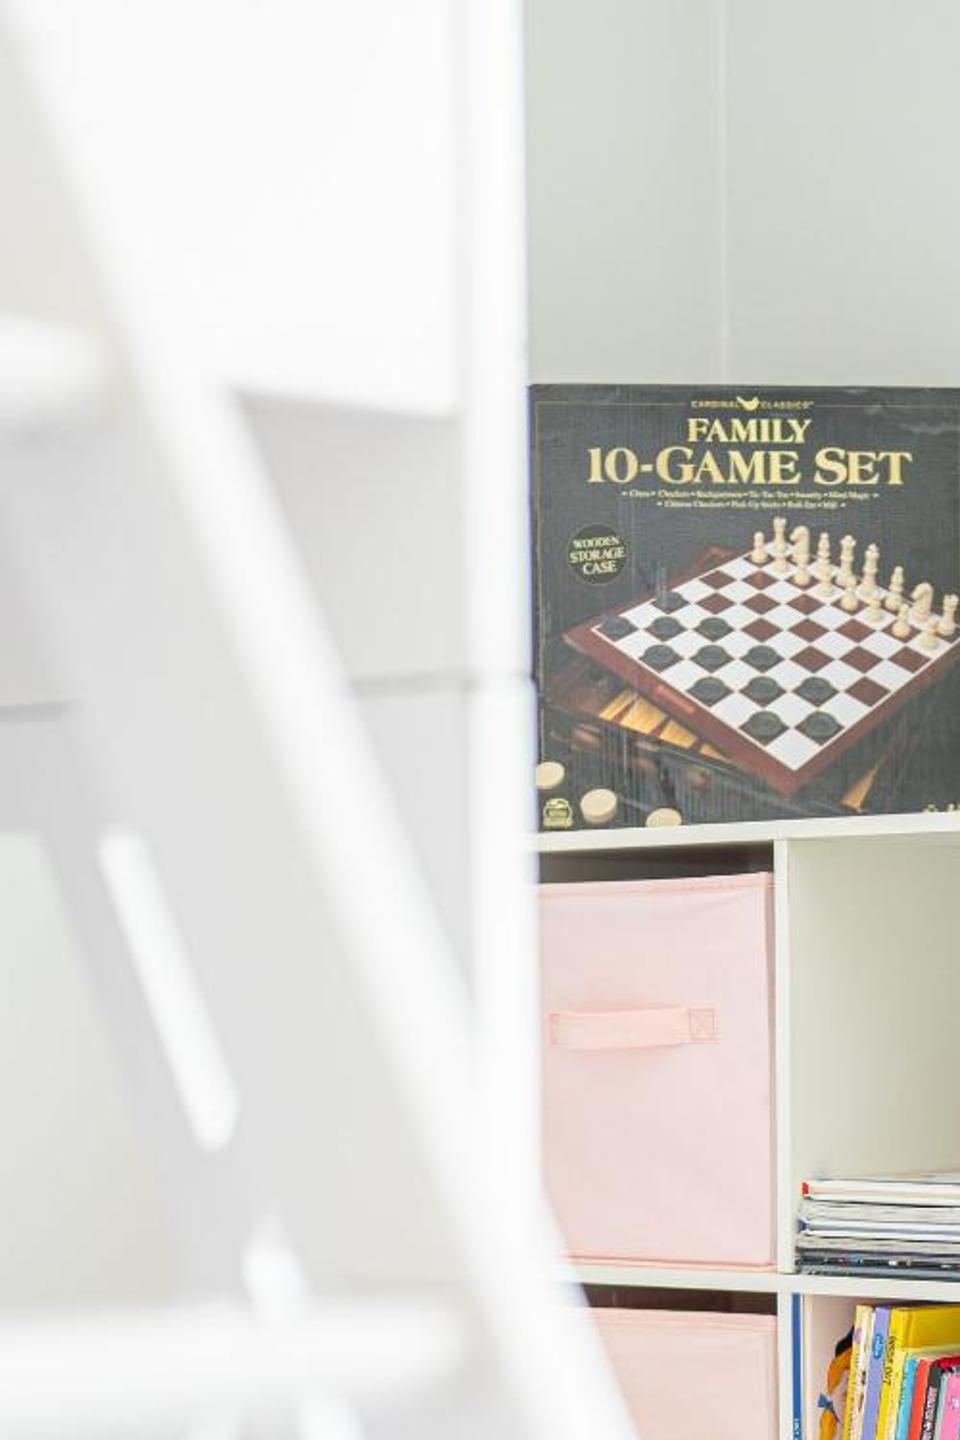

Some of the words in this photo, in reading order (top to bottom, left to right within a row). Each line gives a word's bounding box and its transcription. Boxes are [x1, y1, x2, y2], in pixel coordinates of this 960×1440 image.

[687, 418, 812, 444] FAMILY
[586, 446, 801, 485] 10-GAME
[813, 447, 913, 486] SET
[583, 560, 617, 575] CASE
